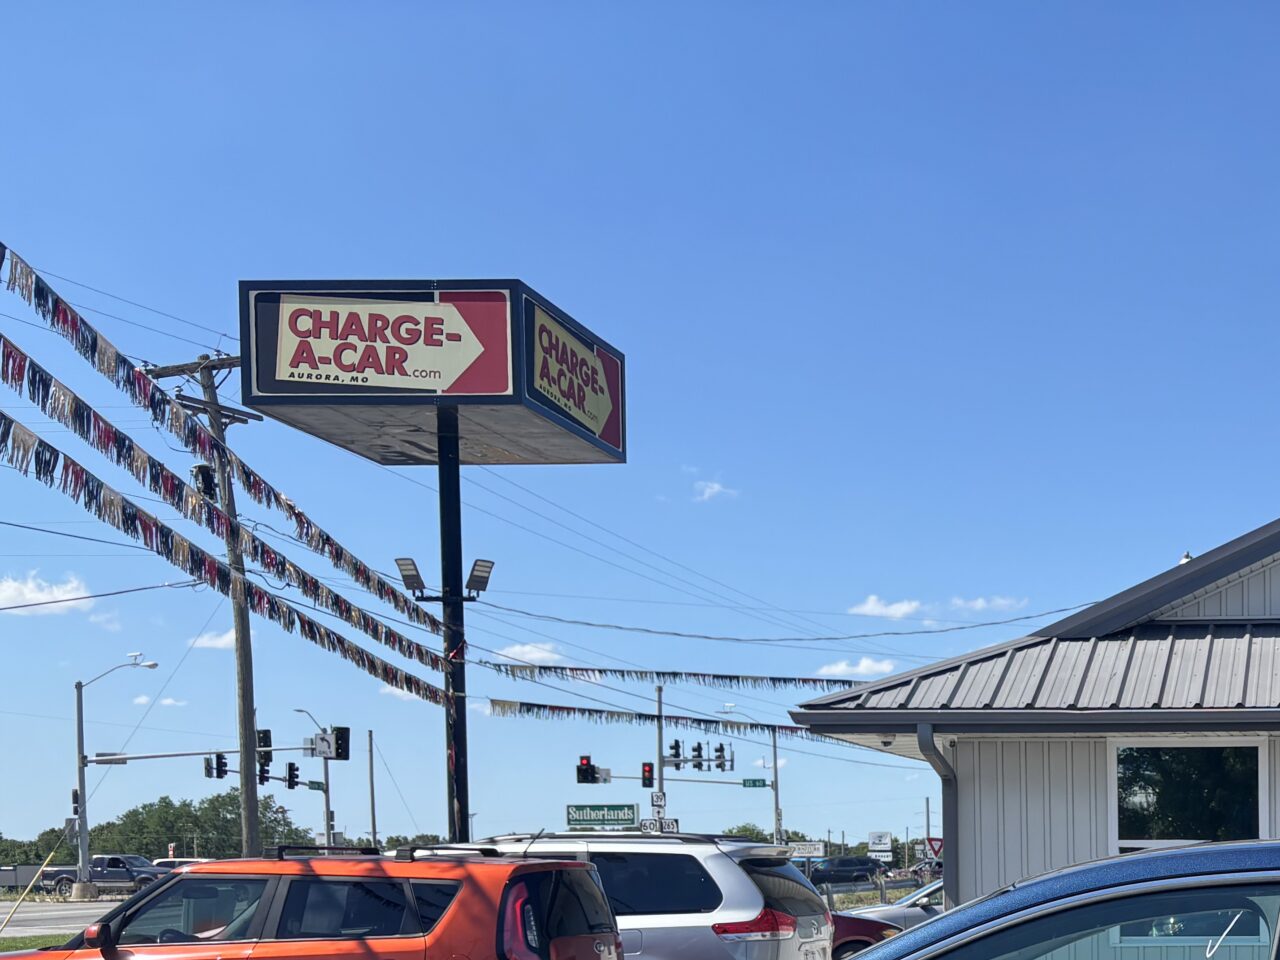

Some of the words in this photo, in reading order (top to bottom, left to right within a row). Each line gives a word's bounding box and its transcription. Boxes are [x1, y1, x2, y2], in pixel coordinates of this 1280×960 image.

[288, 307, 462, 347] CHARGE-
[538, 323, 605, 396] CHARGE-
[288, 371, 345, 383] AURORA,
[349, 376, 369, 384] MO
[654, 794, 663, 803] 39
[568, 806, 634, 820] Sutherlands
[642, 822, 655, 831] 60
[663, 822, 675, 830] 265
